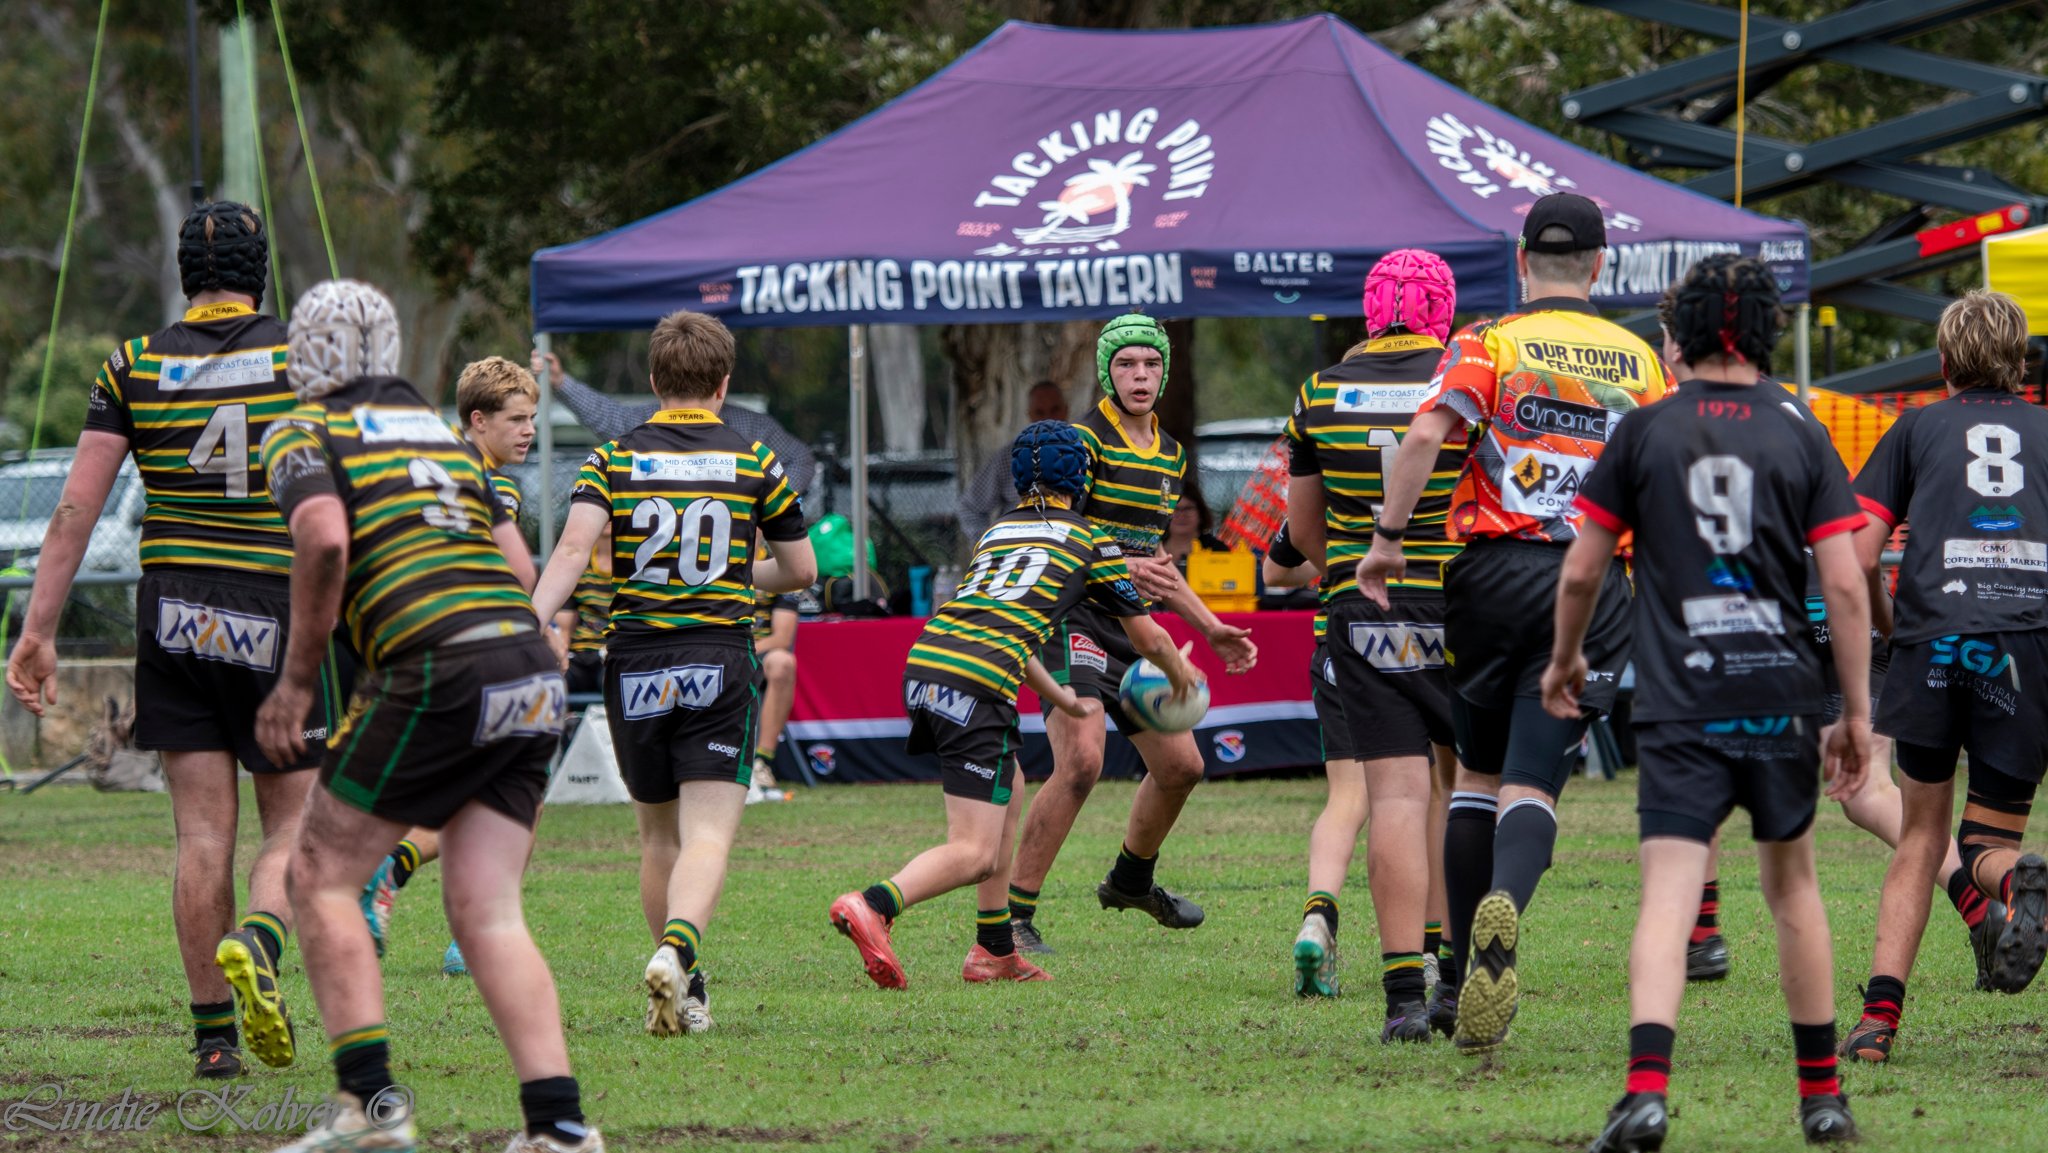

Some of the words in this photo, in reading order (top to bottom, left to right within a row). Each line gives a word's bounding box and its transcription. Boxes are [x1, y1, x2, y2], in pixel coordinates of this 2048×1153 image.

[974, 108, 1158, 207] TACKING
[1234, 252, 1334, 273] BALTER
[736, 259, 904, 314] TACKING
[911, 261, 1027, 310] POINT
[1034, 252, 1183, 307] TAVERN
[209, 306, 239, 315] YEARS
[1393, 339, 1420, 347] YEARS
[212, 359, 239, 371] COAST
[242, 356, 270, 367] GLASS
[1524, 342, 1568, 362] OUR
[1571, 347, 1640, 382] TOWN
[1545, 359, 1620, 384] FENCING
[1371, 390, 1387, 398] MID
[1389, 389, 1417, 398] COAST
[678, 413, 704, 421] YEARS
[1520, 402, 1605, 435] dynamic
[1697, 400, 1752, 421] 1973
[186, 403, 249, 498] 4
[709, 458, 734, 466] GLASS
[1966, 424, 2024, 497] 8
[664, 468, 734, 477] FENCING
[408, 457, 471, 533] 3
[1688, 455, 1754, 554] 9
[629, 496, 732, 586] 20
[1982, 545, 2006, 553] CMM
[1945, 557, 1974, 565] COFFS
[1976, 556, 2008, 564] METAL
[956, 547, 1050, 601] 10
[1977, 582, 1992, 591] Big
[1994, 583, 2026, 595] Country
[303, 728, 327, 739] OOSEY
[708, 742, 740, 754] GOOSEY
[964, 763, 995, 778] GOOSEY
